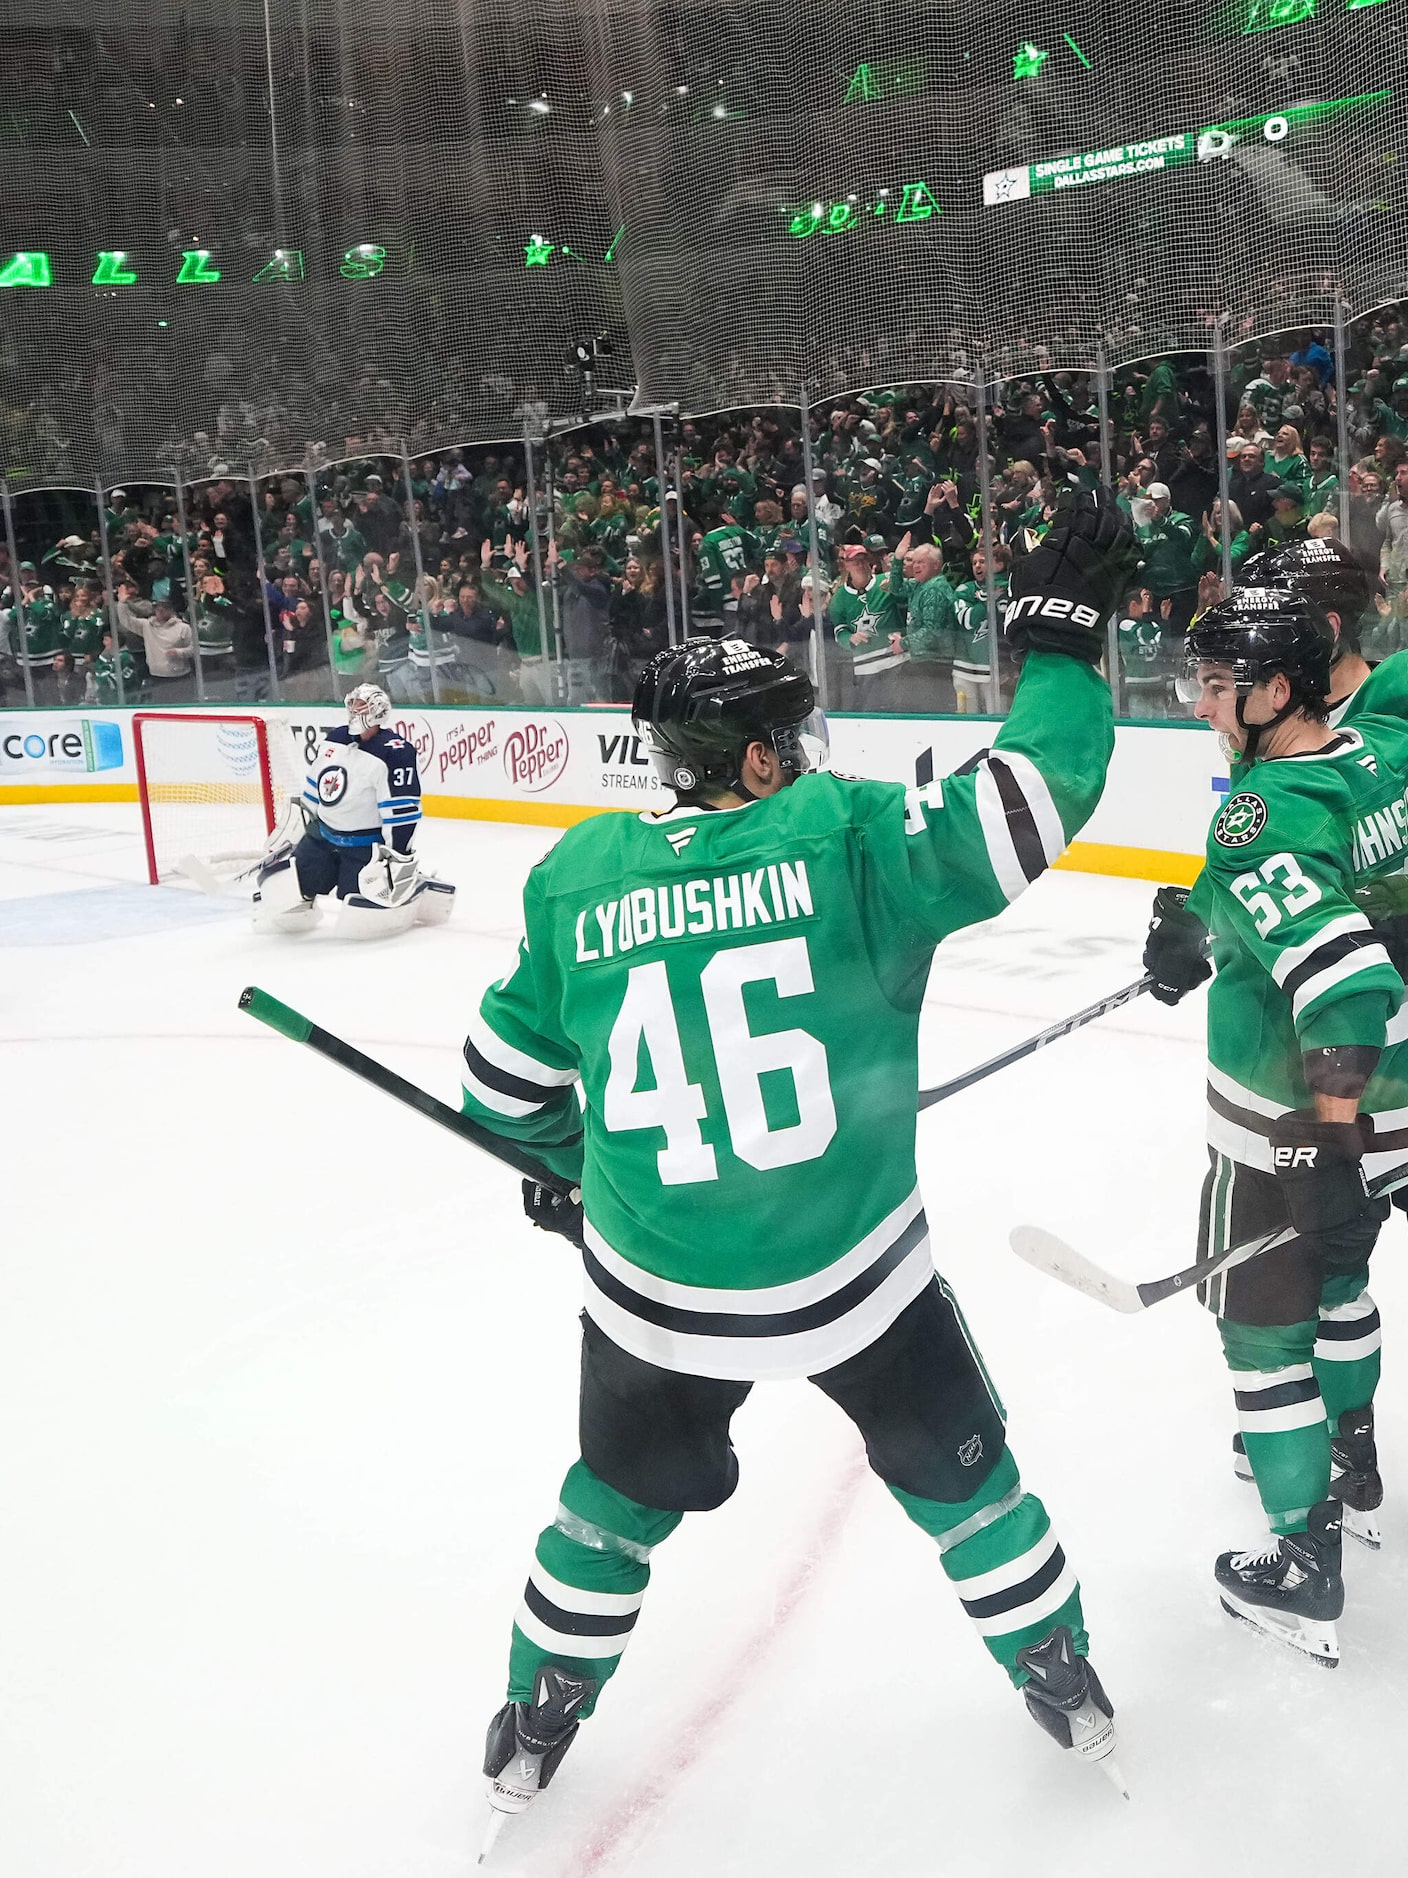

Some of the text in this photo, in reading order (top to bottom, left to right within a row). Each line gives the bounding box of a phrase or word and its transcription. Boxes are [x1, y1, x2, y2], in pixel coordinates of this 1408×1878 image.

[1263, 116, 1289, 142] 0
[1035, 134, 1185, 178] SINGLE GAME TICKETS
[1054, 155, 1166, 189] DALLASSTARS.COM
[1300, 553, 1342, 565] TRANSFER
[1302, 547, 1336, 558] ENERGY
[1232, 602, 1280, 612] TRANSFER
[721, 651, 763, 666] ENERGY
[721, 657, 773, 676] TRANSFER
[3, 733, 83, 759] core
[523, 723, 548, 757] Dr
[438, 719, 496, 784] pepper
[476, 745, 499, 766] THING
[503, 730, 565, 785] Pepper
[393, 766, 415, 787] 37
[601, 773, 648, 791] STREAM
[576, 860, 815, 964] LYUBUSHKIN
[1157, 981, 1180, 994] CCM
[604, 936, 839, 1186] 46
[1285, 1538, 1316, 1560] CATALYST
[1262, 1578, 1276, 1586] PRO
